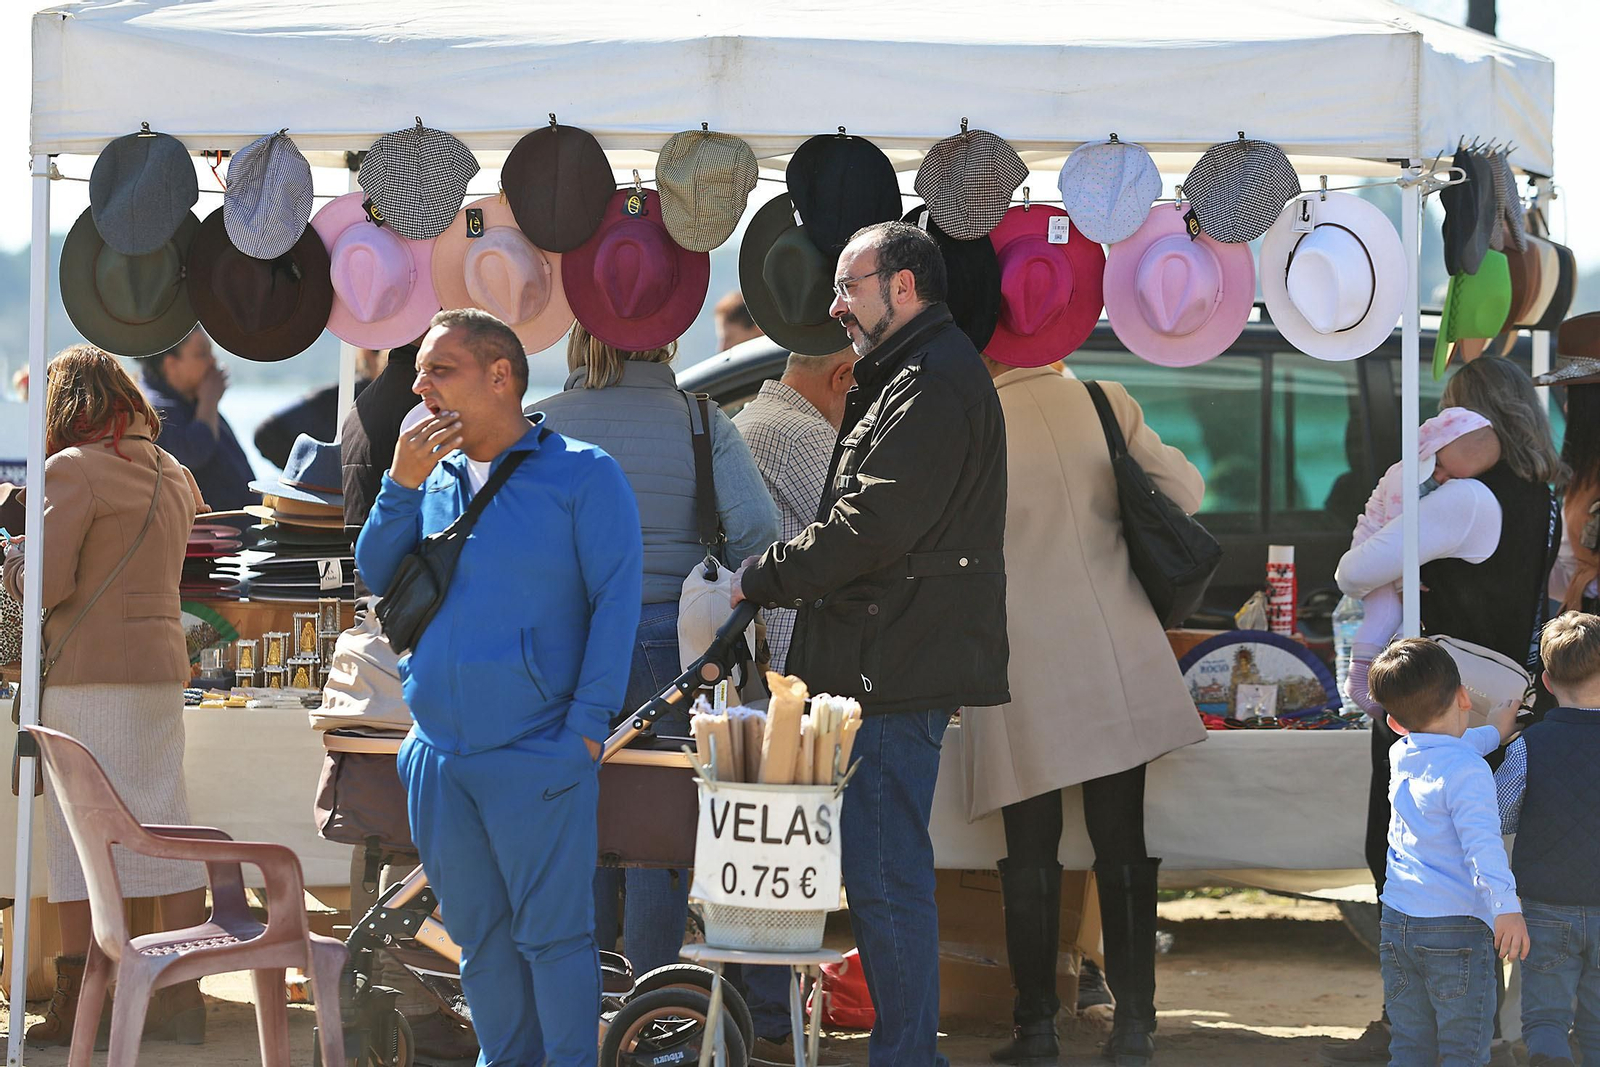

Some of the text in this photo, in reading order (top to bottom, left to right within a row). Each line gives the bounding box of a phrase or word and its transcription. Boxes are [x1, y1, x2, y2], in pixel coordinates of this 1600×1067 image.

[711, 798, 832, 845] VELAS
[721, 862, 817, 899] 0.75 €
